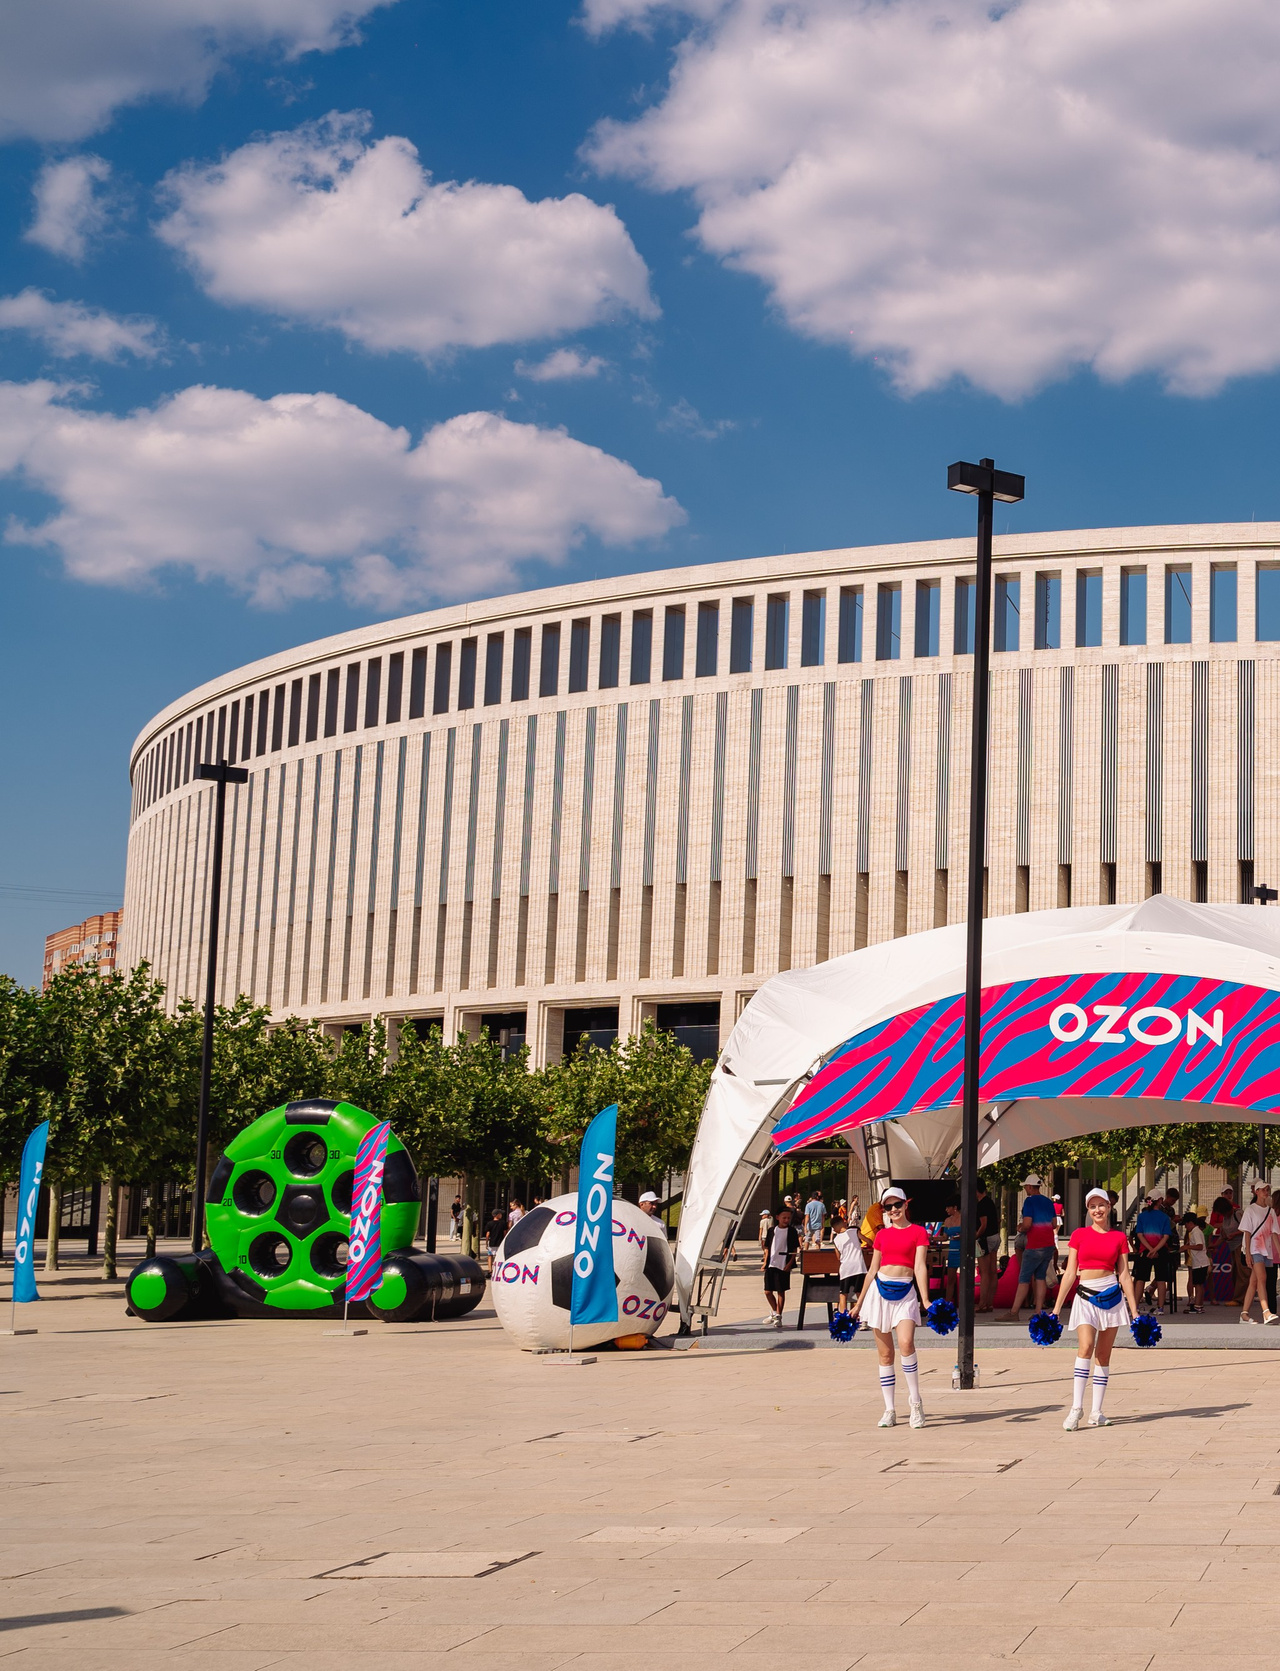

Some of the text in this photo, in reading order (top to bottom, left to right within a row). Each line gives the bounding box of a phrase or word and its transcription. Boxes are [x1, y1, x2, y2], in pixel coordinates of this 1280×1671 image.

[1049, 1003, 1224, 1047] OZON
[271, 1150, 281, 1159] 30
[329, 1151, 340, 1159] 30
[223, 1198, 233, 1206] 20
[349, 1160, 384, 1263] OZON
[574, 1152, 613, 1279] OZON
[555, 1211, 646, 1251] OON
[239, 1255, 247, 1264] 10
[1212, 1263, 1232, 1273] ZO
[622, 1294, 668, 1322] OZO
